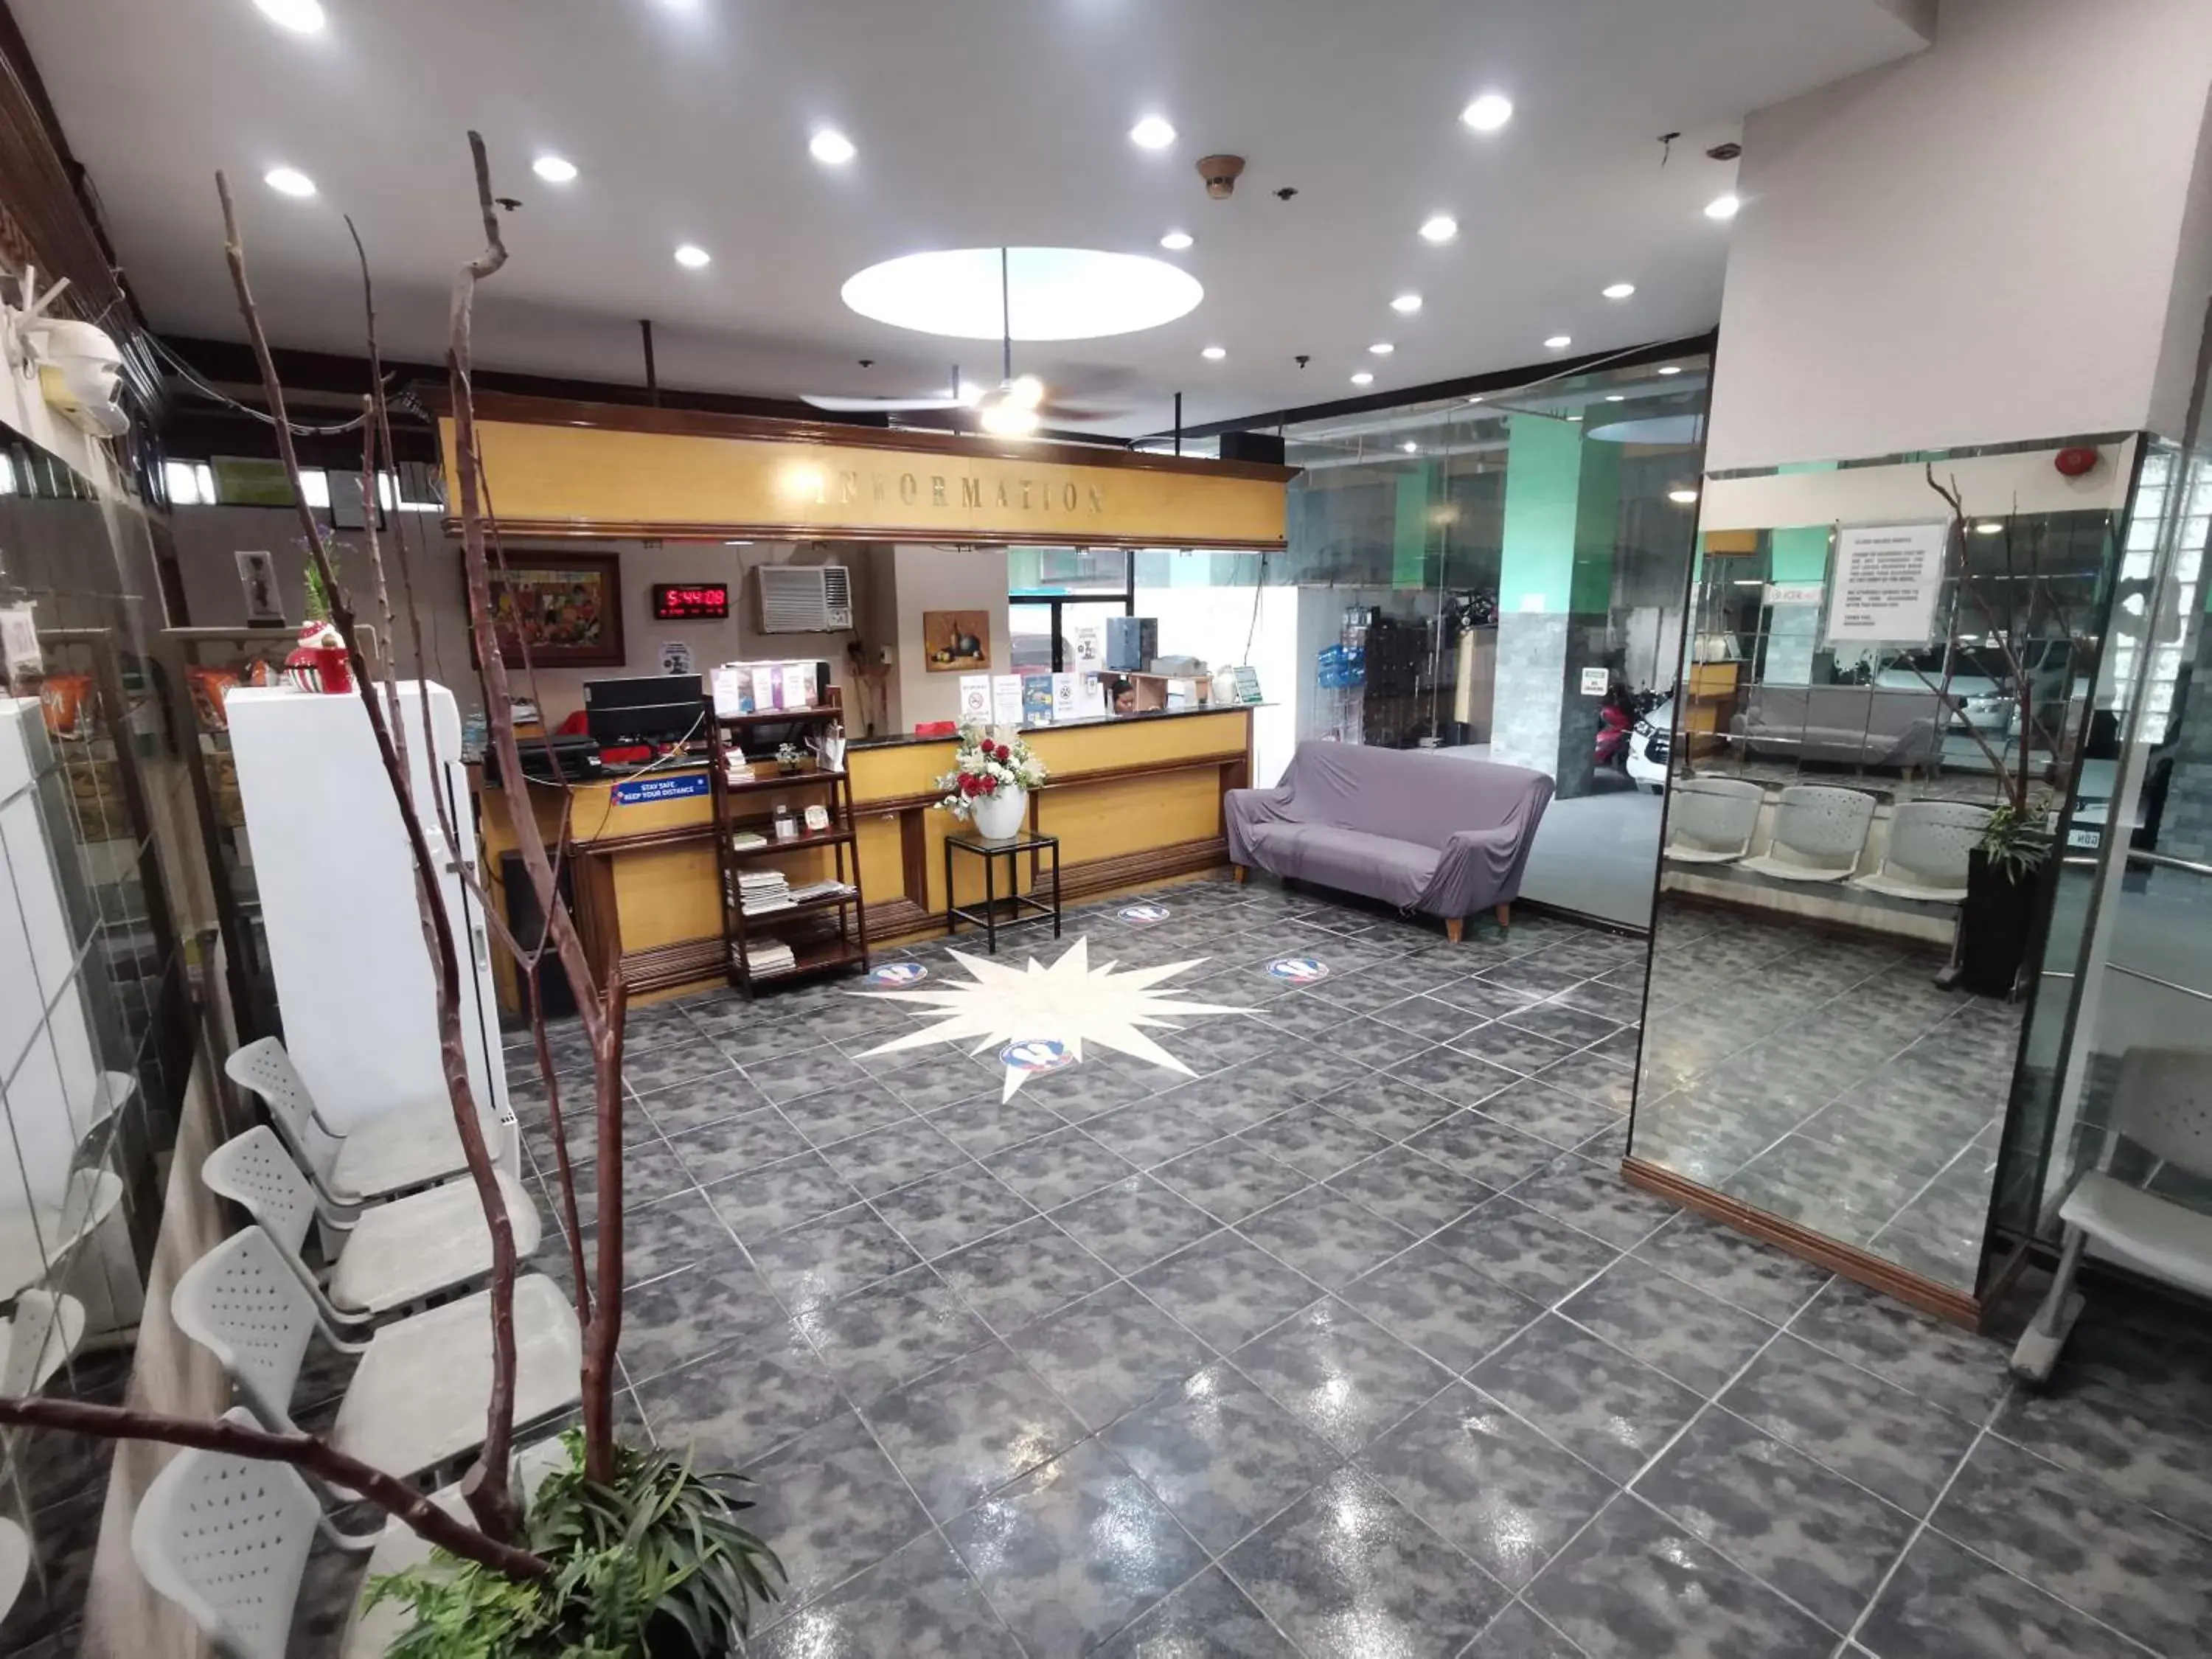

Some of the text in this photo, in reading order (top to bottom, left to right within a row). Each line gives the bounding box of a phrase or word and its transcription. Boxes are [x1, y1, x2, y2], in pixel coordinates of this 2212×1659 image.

[641, 783, 658, 791] STAY
[625, 786, 694, 801] KEEP YOUR DISTANCE
